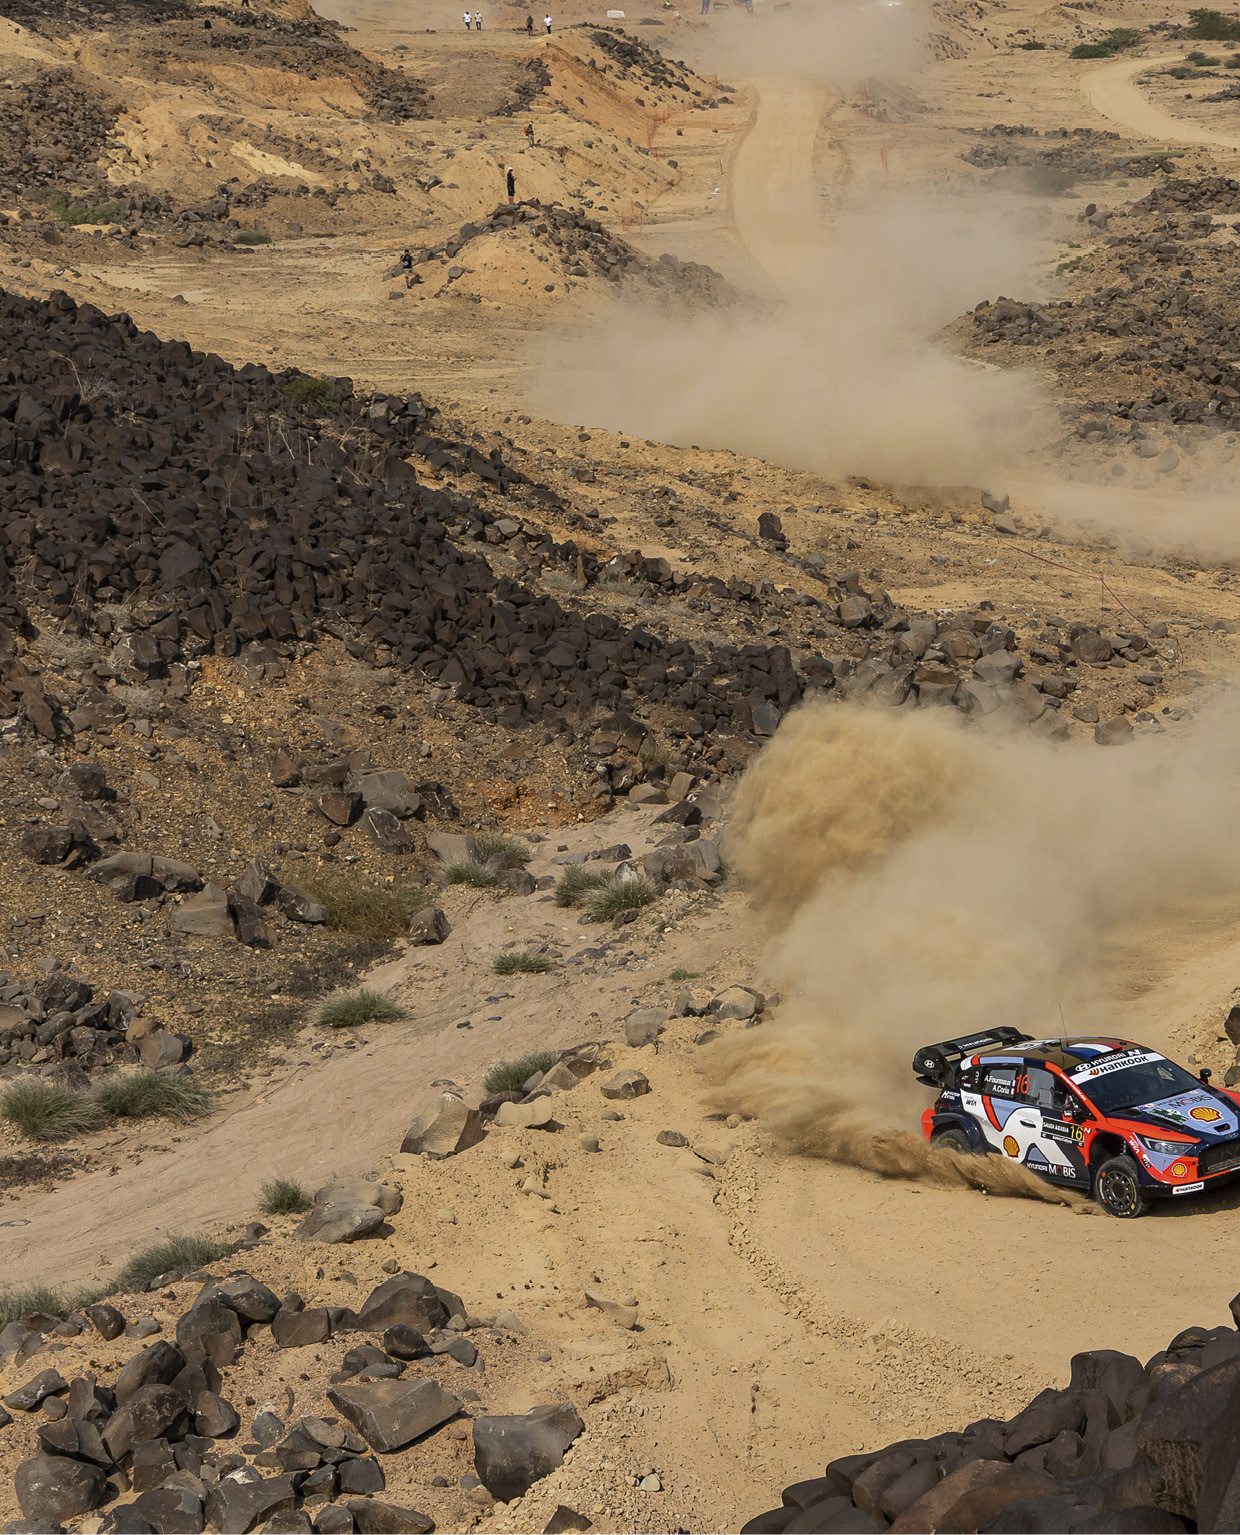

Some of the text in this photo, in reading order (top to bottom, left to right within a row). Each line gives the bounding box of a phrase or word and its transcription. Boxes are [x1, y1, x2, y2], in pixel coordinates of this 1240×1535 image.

[1091, 1052, 1127, 1066] HYUNDAI
[1016, 1074, 1032, 1094] 16
[1070, 1125, 1083, 1140] 16
[1048, 1164, 1076, 1179] MOBIS
